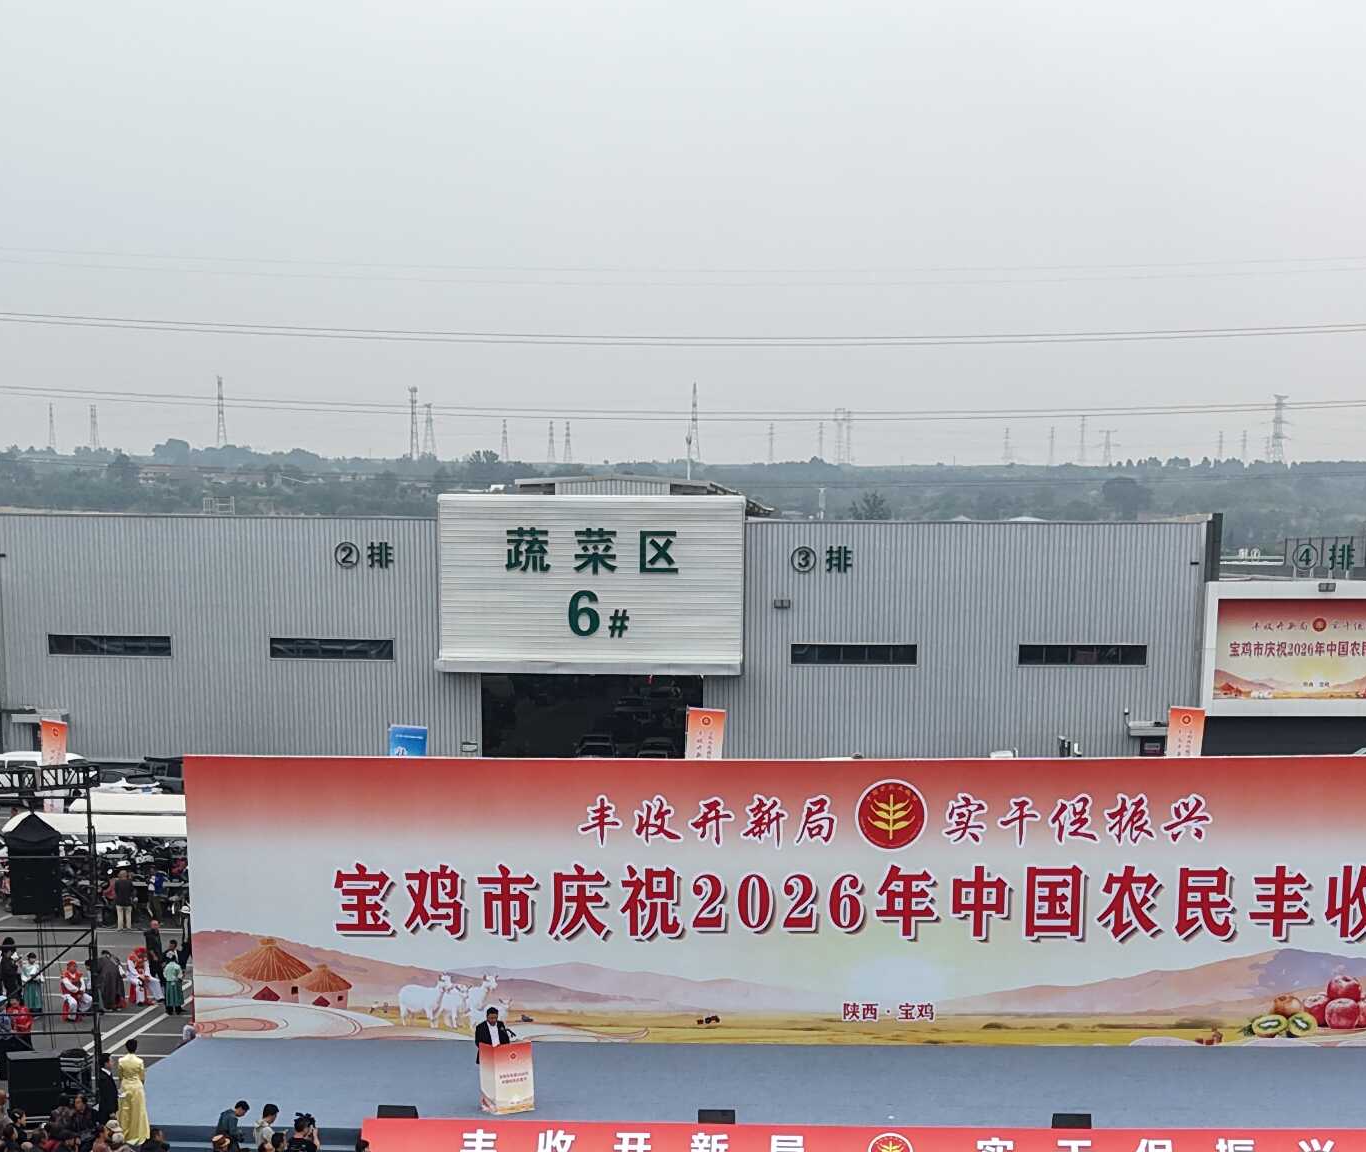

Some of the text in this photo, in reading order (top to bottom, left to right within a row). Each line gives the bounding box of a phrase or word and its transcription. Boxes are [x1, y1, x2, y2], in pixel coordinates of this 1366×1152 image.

[506, 527, 679, 575] 蔬菜区
[568, 590, 629, 638] 6#
[577, 793, 1213, 848] 丰收开新局 实干促振兴
